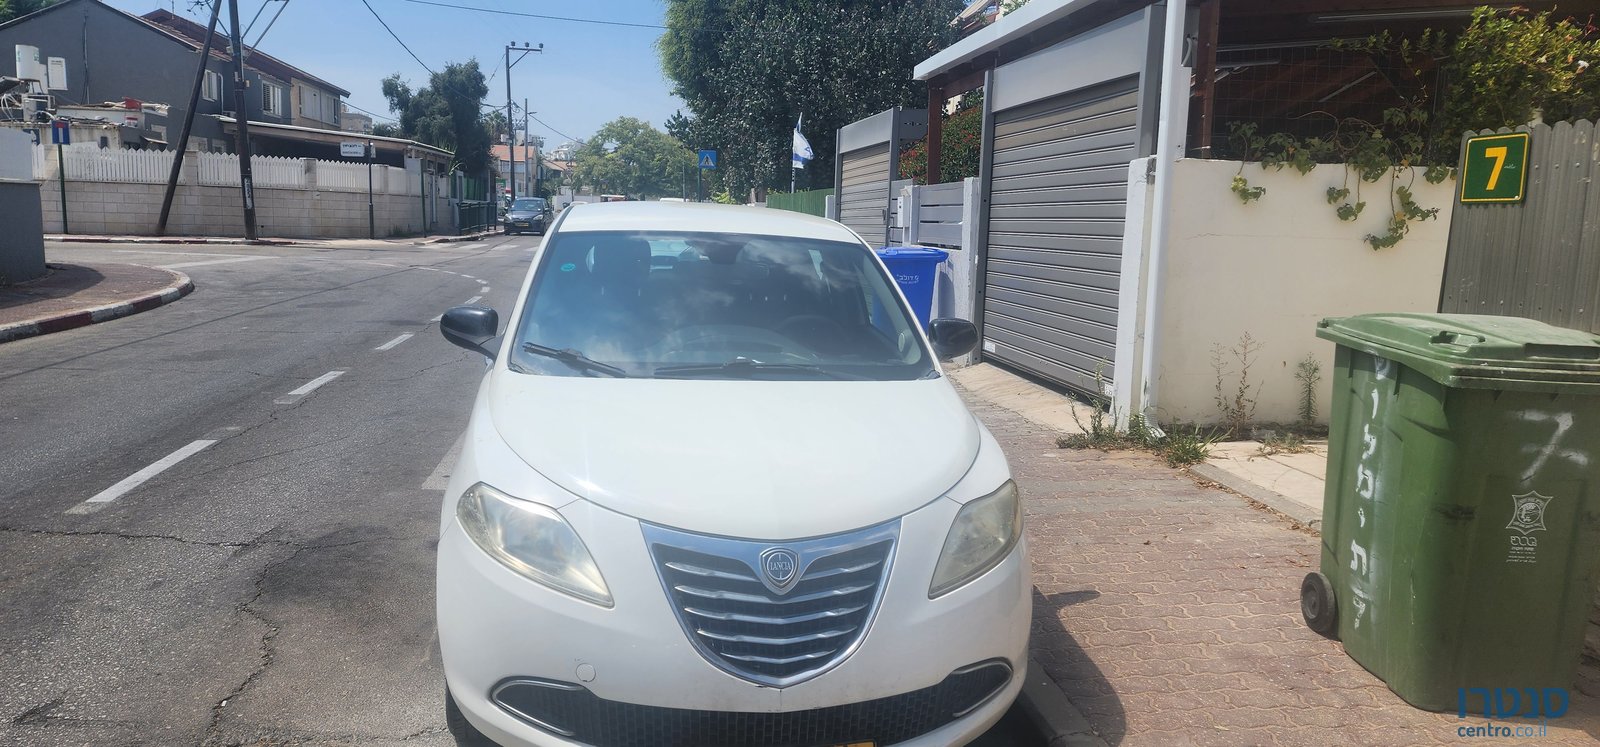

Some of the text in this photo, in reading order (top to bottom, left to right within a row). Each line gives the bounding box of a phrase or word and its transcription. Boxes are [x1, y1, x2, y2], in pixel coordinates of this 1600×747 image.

[1485, 146, 1508, 191] 7
[1514, 411, 1588, 486] 7
[770, 561, 791, 571] LANCIA
